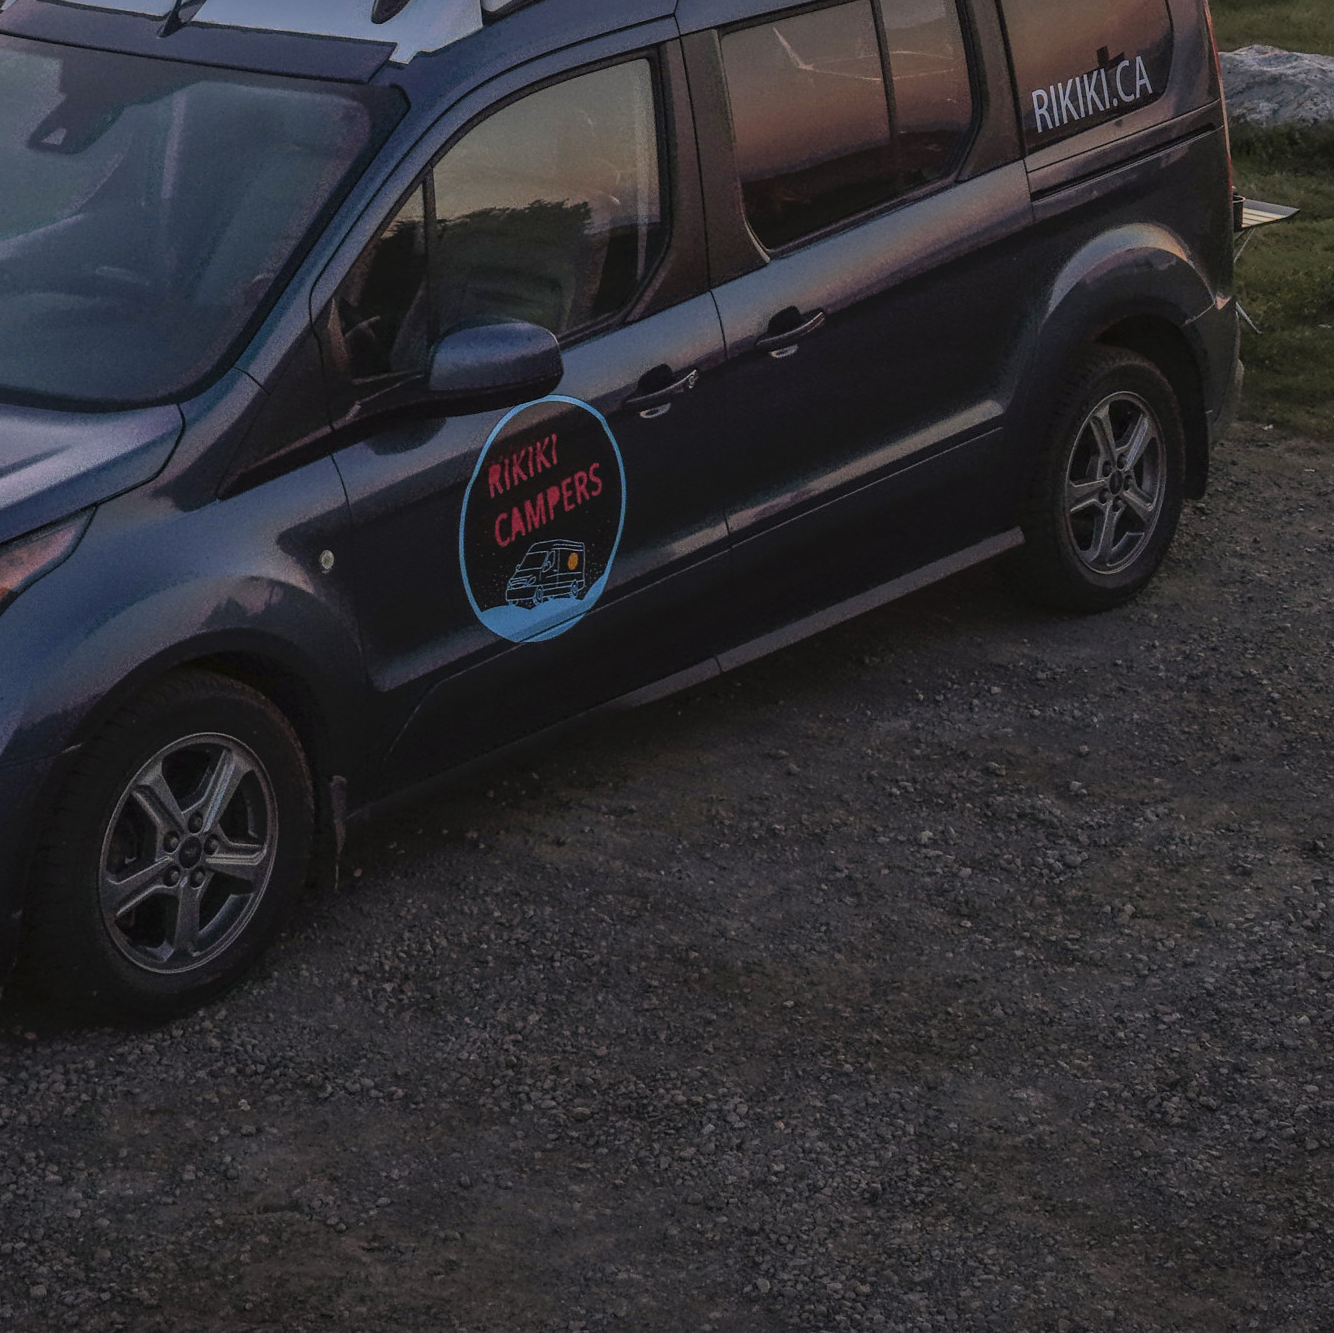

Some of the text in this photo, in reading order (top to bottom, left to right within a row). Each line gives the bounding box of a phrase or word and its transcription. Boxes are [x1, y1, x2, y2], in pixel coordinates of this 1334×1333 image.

[1032, 56, 1153, 133] RIKIKI.CA
[488, 433, 558, 499] RIKIKI
[494, 462, 603, 547] CAMPERS
